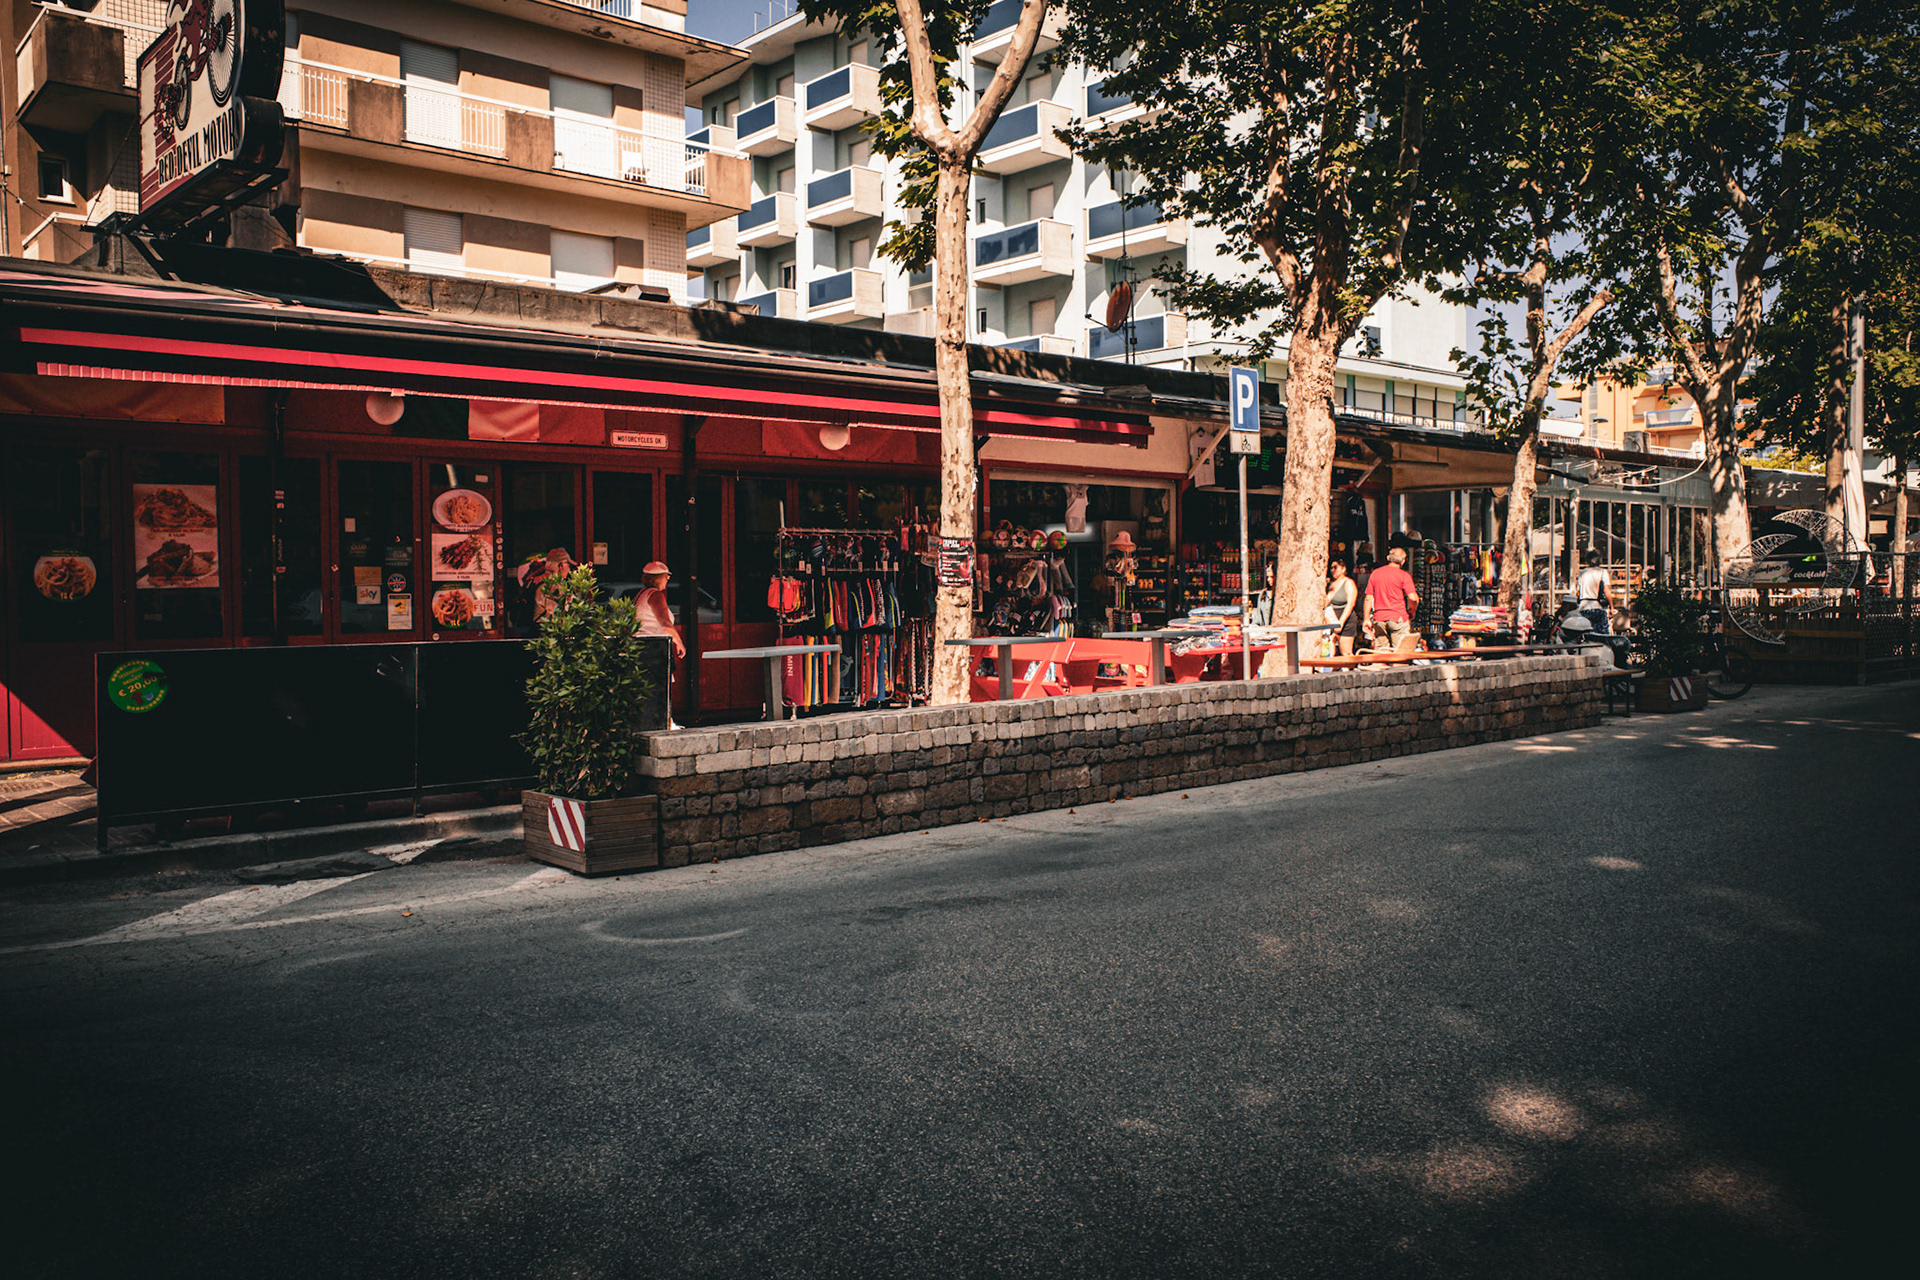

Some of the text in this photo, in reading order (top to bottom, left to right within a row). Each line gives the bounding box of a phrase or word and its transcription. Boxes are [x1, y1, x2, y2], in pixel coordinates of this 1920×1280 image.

[158, 151, 176, 185] RED
[176, 132, 202, 176] DEVIL
[1236, 373, 1255, 425] P
[617, 435, 653, 444] MOTORCYCLES
[359, 588, 377, 600] sky
[473, 603, 493, 612] FUN
